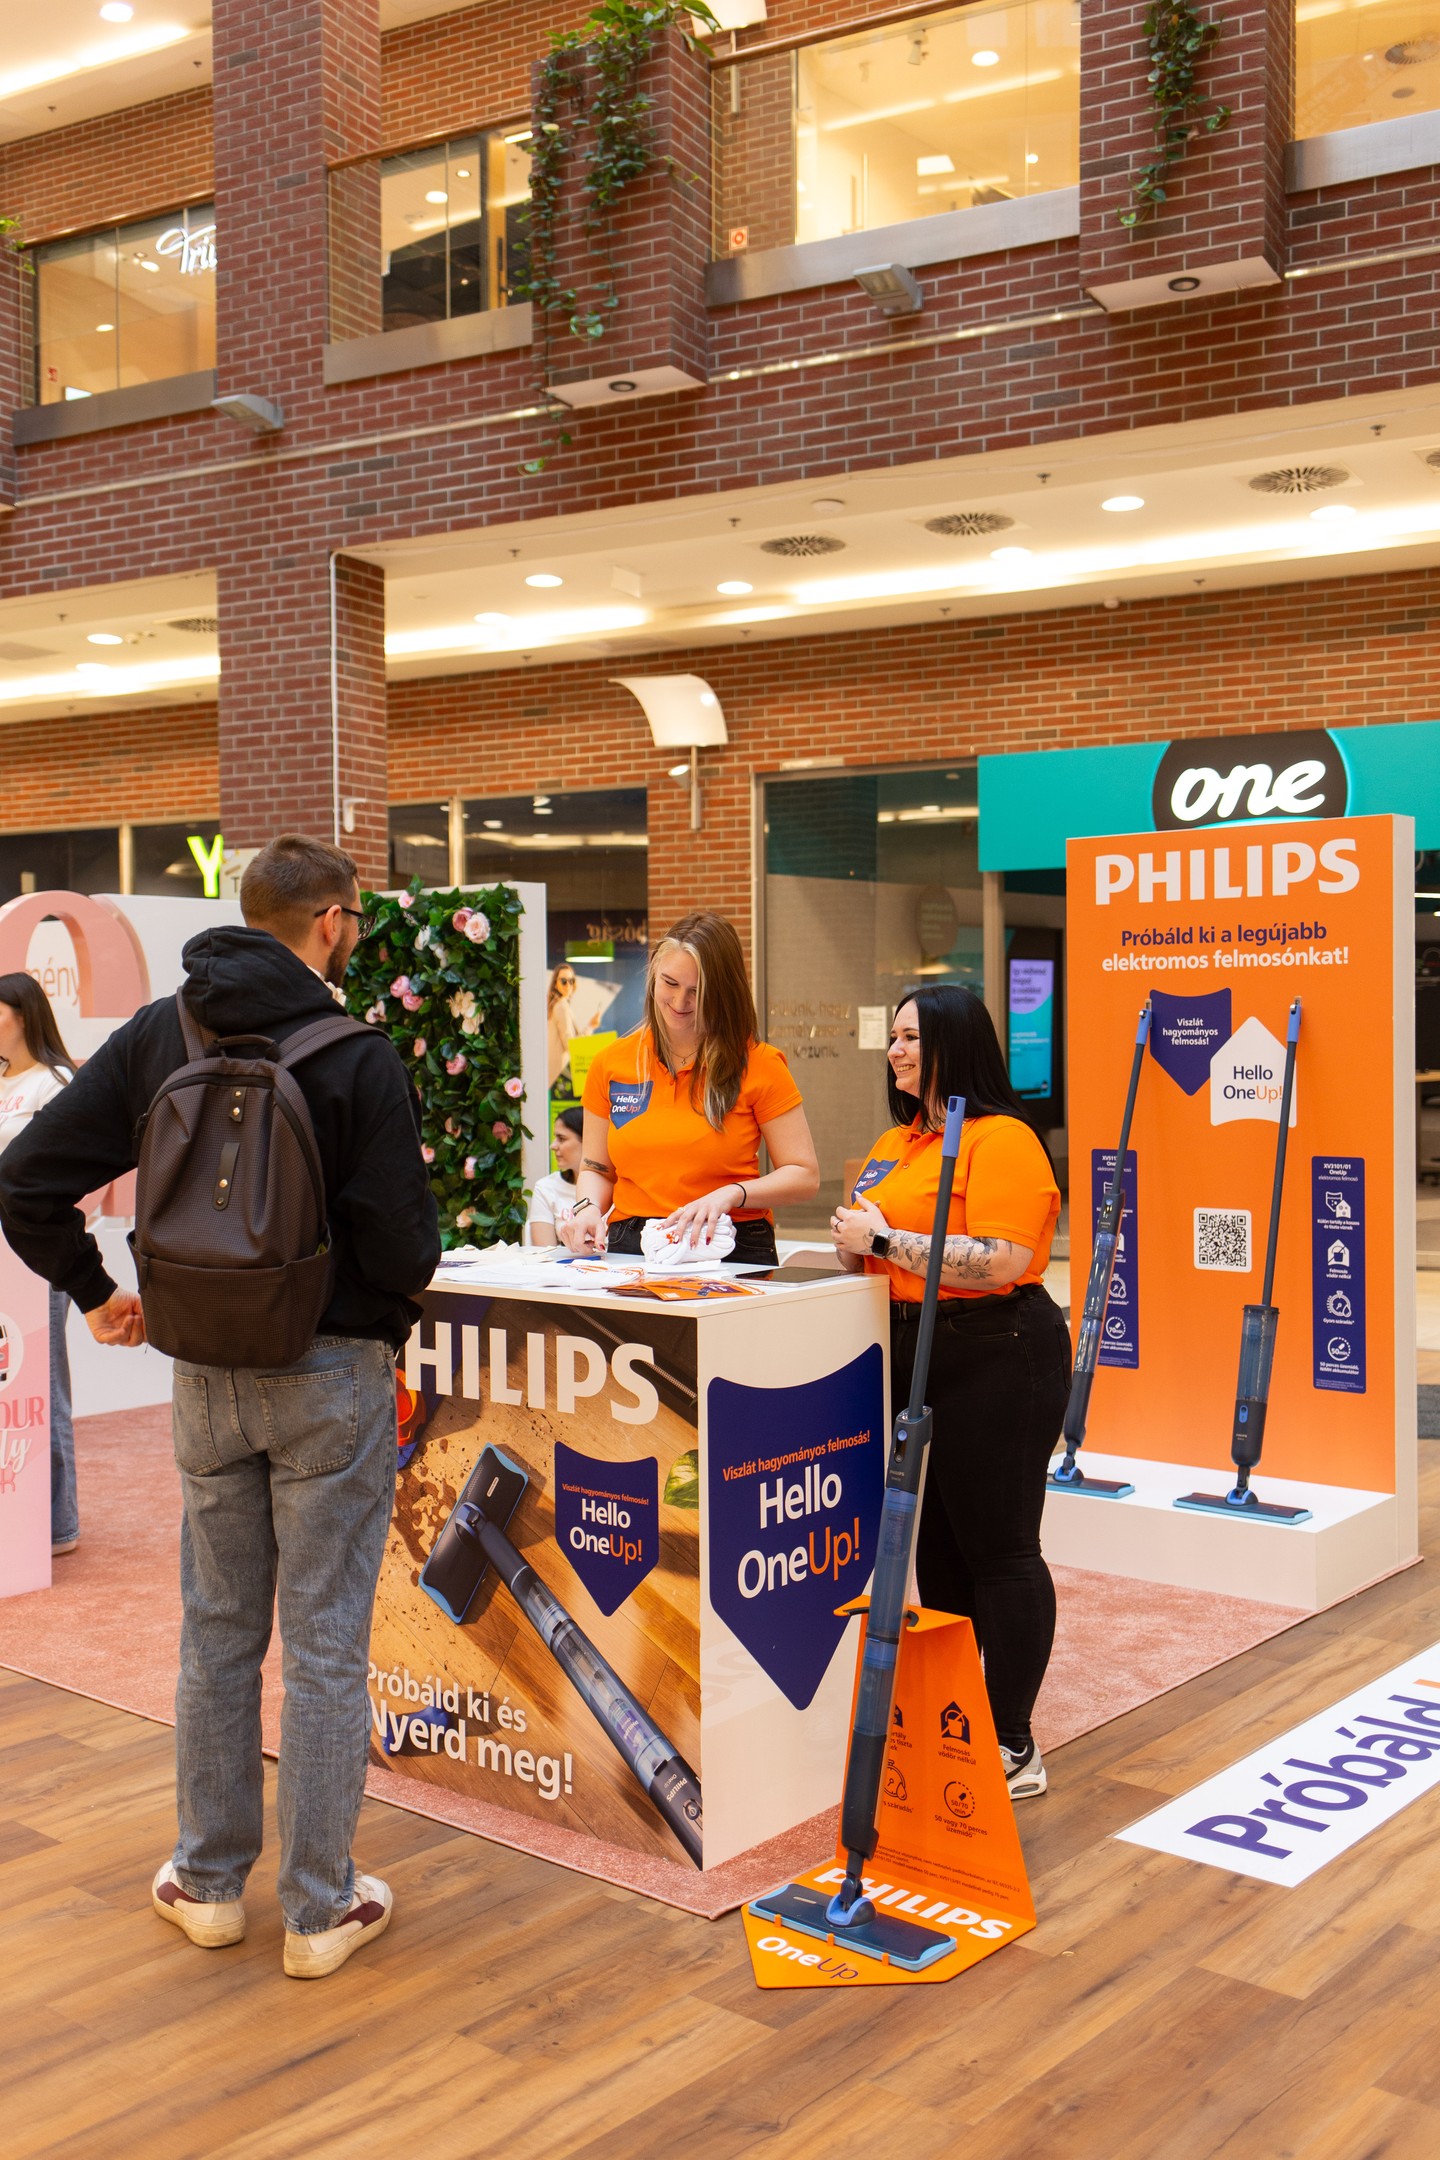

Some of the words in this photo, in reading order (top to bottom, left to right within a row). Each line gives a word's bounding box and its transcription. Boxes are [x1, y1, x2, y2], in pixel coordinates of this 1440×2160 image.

[1171, 760, 1326, 821] one
[1096, 838, 1360, 905] PHILIPS
[1121, 926, 1193, 946] Próbáld
[1199, 926, 1216, 944] ki
[1221, 928, 1232, 942] a
[1237, 921, 1327, 946] legújabb
[1102, 952, 1209, 972] elektromos
[1213, 946, 1349, 969] felmosónkat!
[1162, 1028, 1218, 1037] hagyományos
[1176, 1018, 1204, 1027] Viszlát
[1171, 1037, 1209, 1046] felmosás!
[1233, 1065, 1273, 1080] Hello
[616, 1096, 638, 1104] Hello
[1224, 1085, 1282, 1104] OneUp!
[612, 1105, 641, 1114] OneUp!
[404, 1319, 659, 1425] HILIPS
[722, 1460, 756, 1482] Viszlát
[758, 1444, 826, 1472] hagyományos
[828, 1430, 870, 1452] felmosás!
[562, 1483, 581, 1493] Viszlát
[581, 1488, 621, 1500] hagyományos
[621, 1494, 649, 1505] felmosás!
[760, 1463, 843, 1529] Hello
[582, 1498, 631, 1528] Hello
[569, 1526, 643, 1566] OneUp!
[738, 1517, 860, 1599] OneUp!
[367, 1661, 459, 1715] Próbáld
[467, 1686, 490, 1723] ki
[497, 1696, 527, 1732] és
[370, 1696, 467, 1762] Nyerd
[478, 1737, 573, 1801] meg!
[897, 1739, 912, 1748] tiszta
[943, 1744, 971, 1757] Felmosás
[938, 1750, 956, 1761] vödör
[957, 1753, 976, 1766] nélkül
[666, 1777, 688, 1802] PHILIPS
[951, 1799, 969, 1810] 50/70
[954, 1807, 966, 1815] min
[934, 1814, 942, 1822] 50
[943, 1816, 958, 1828] vagy
[959, 1821, 967, 1829] 70
[968, 1823, 988, 1836] perces
[813, 1867, 1013, 1939] PHILIPS
[756, 1936, 859, 1980] OneUp
